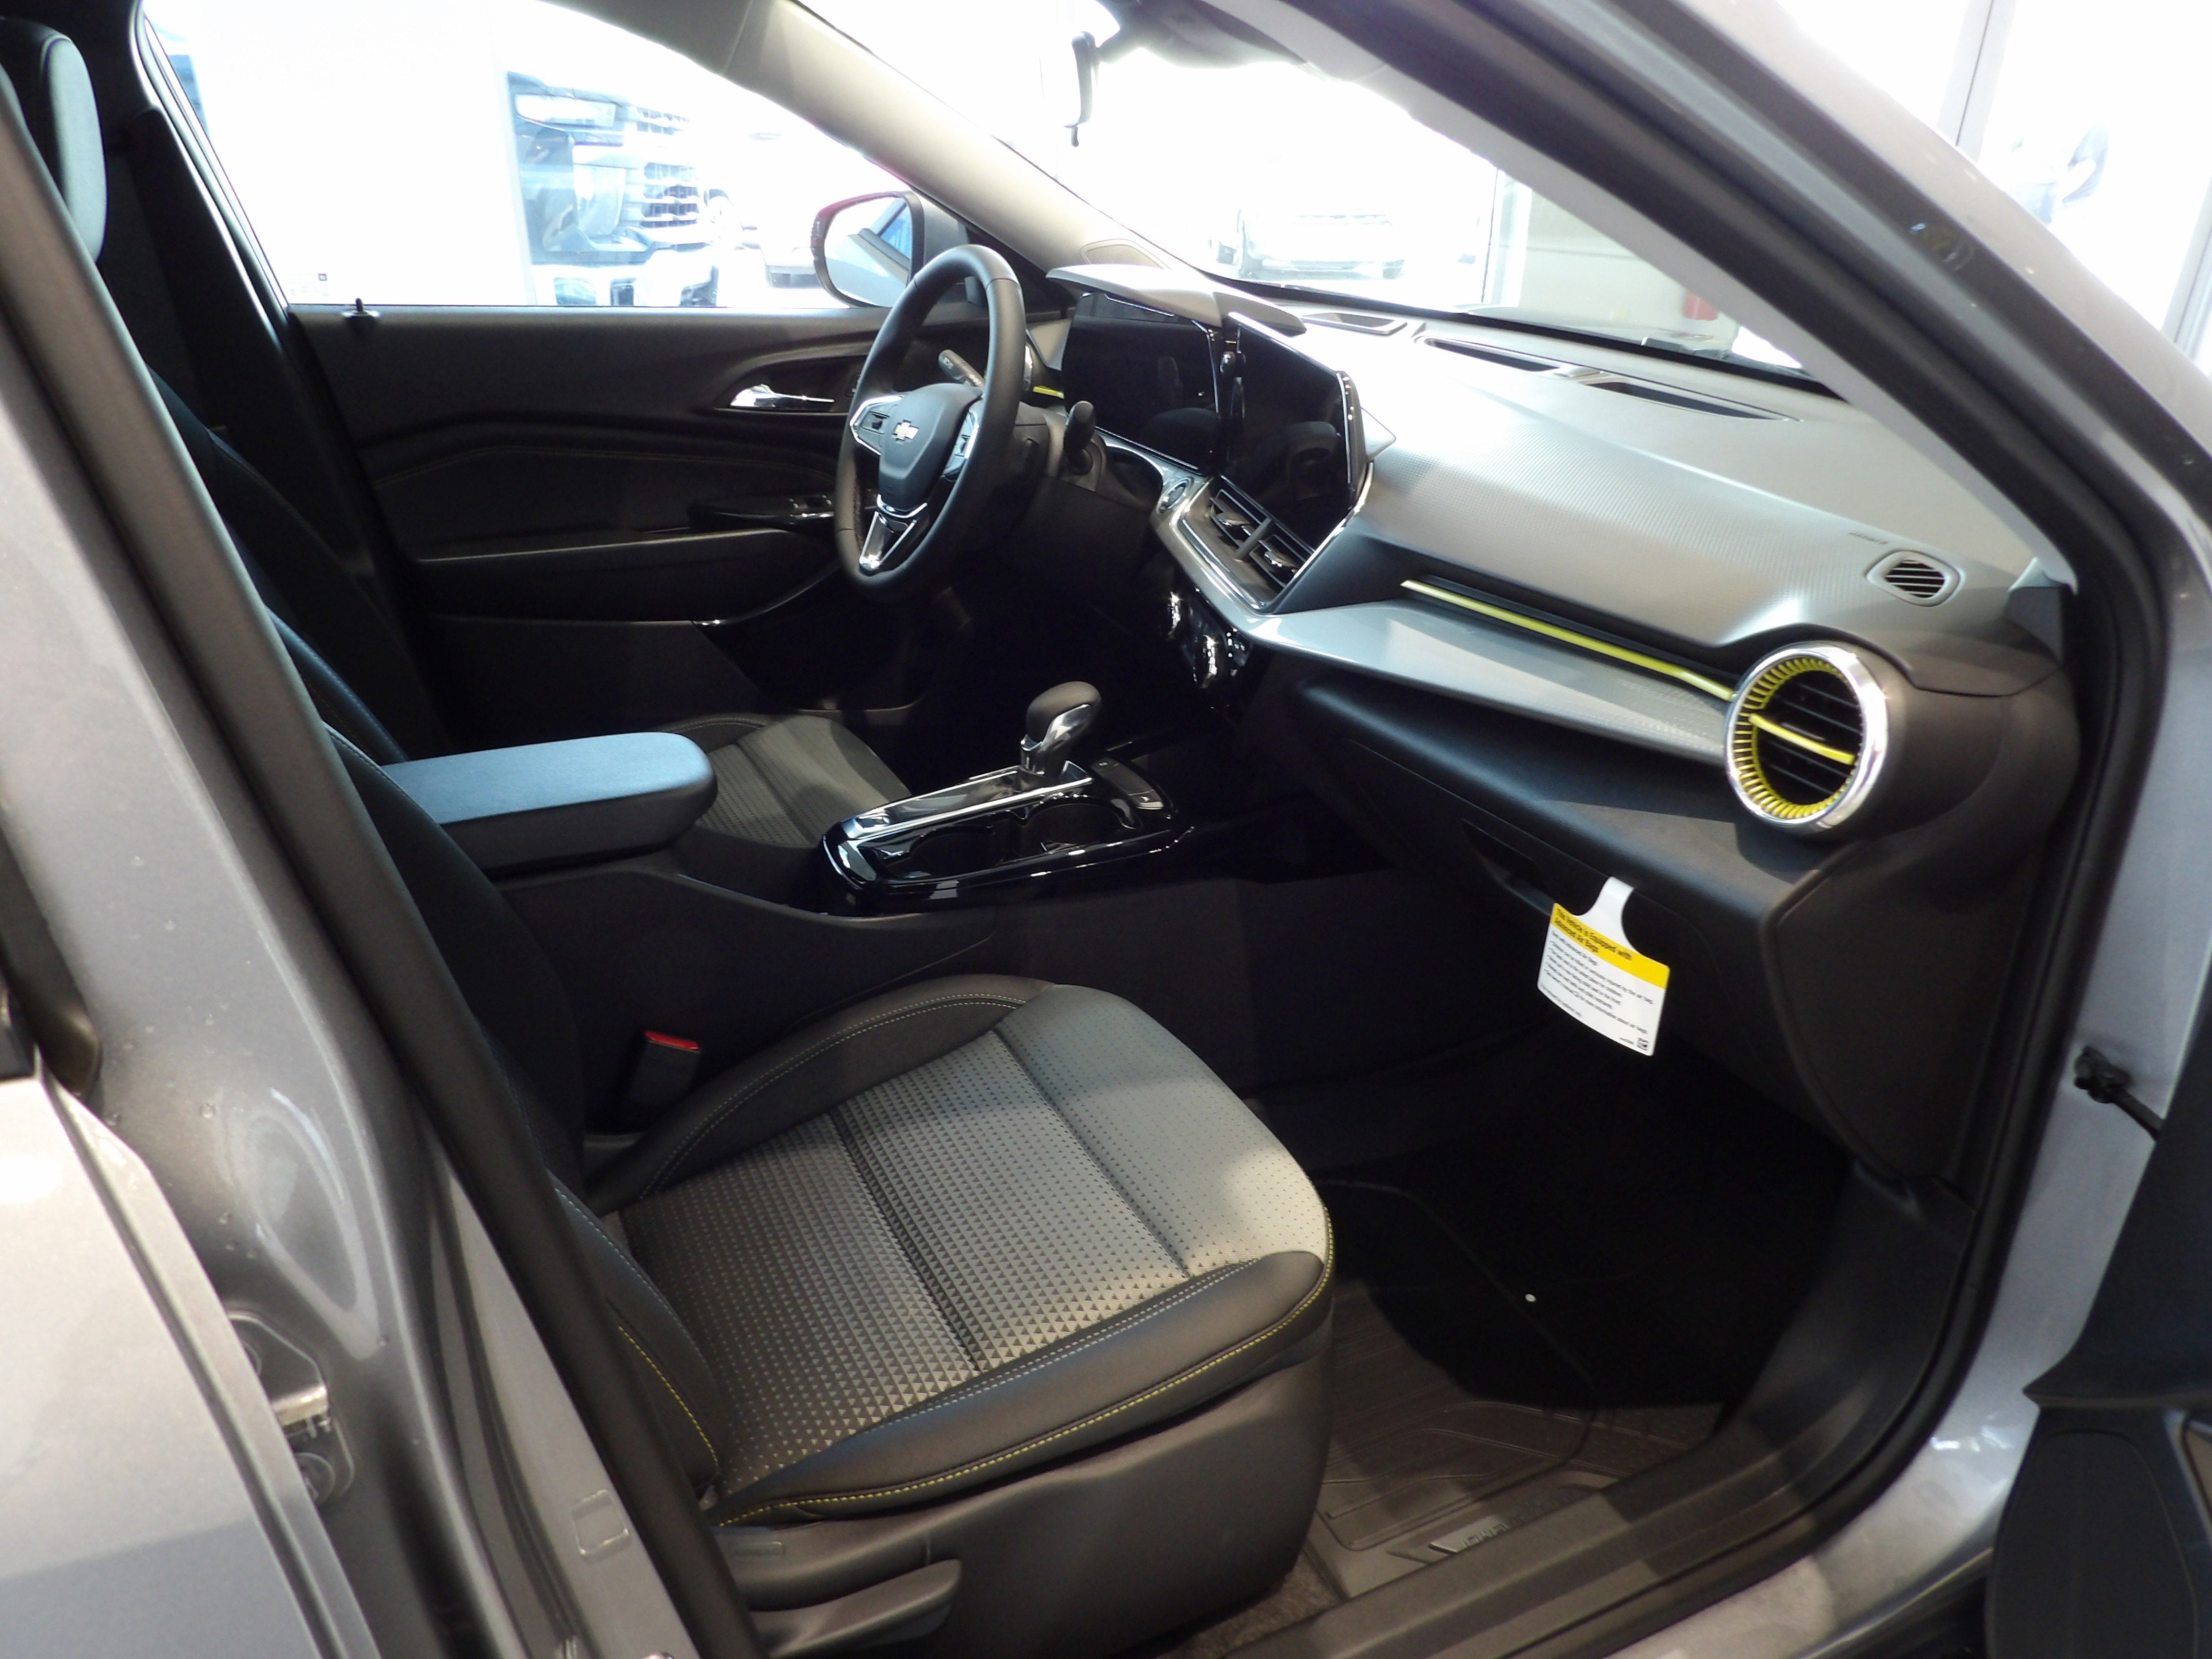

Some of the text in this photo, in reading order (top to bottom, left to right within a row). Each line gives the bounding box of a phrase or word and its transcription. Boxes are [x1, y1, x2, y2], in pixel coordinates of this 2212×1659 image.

[1585, 939, 1599, 953] Bags
[1589, 933, 1616, 952] Equipped
[1618, 950, 1633, 961] with
